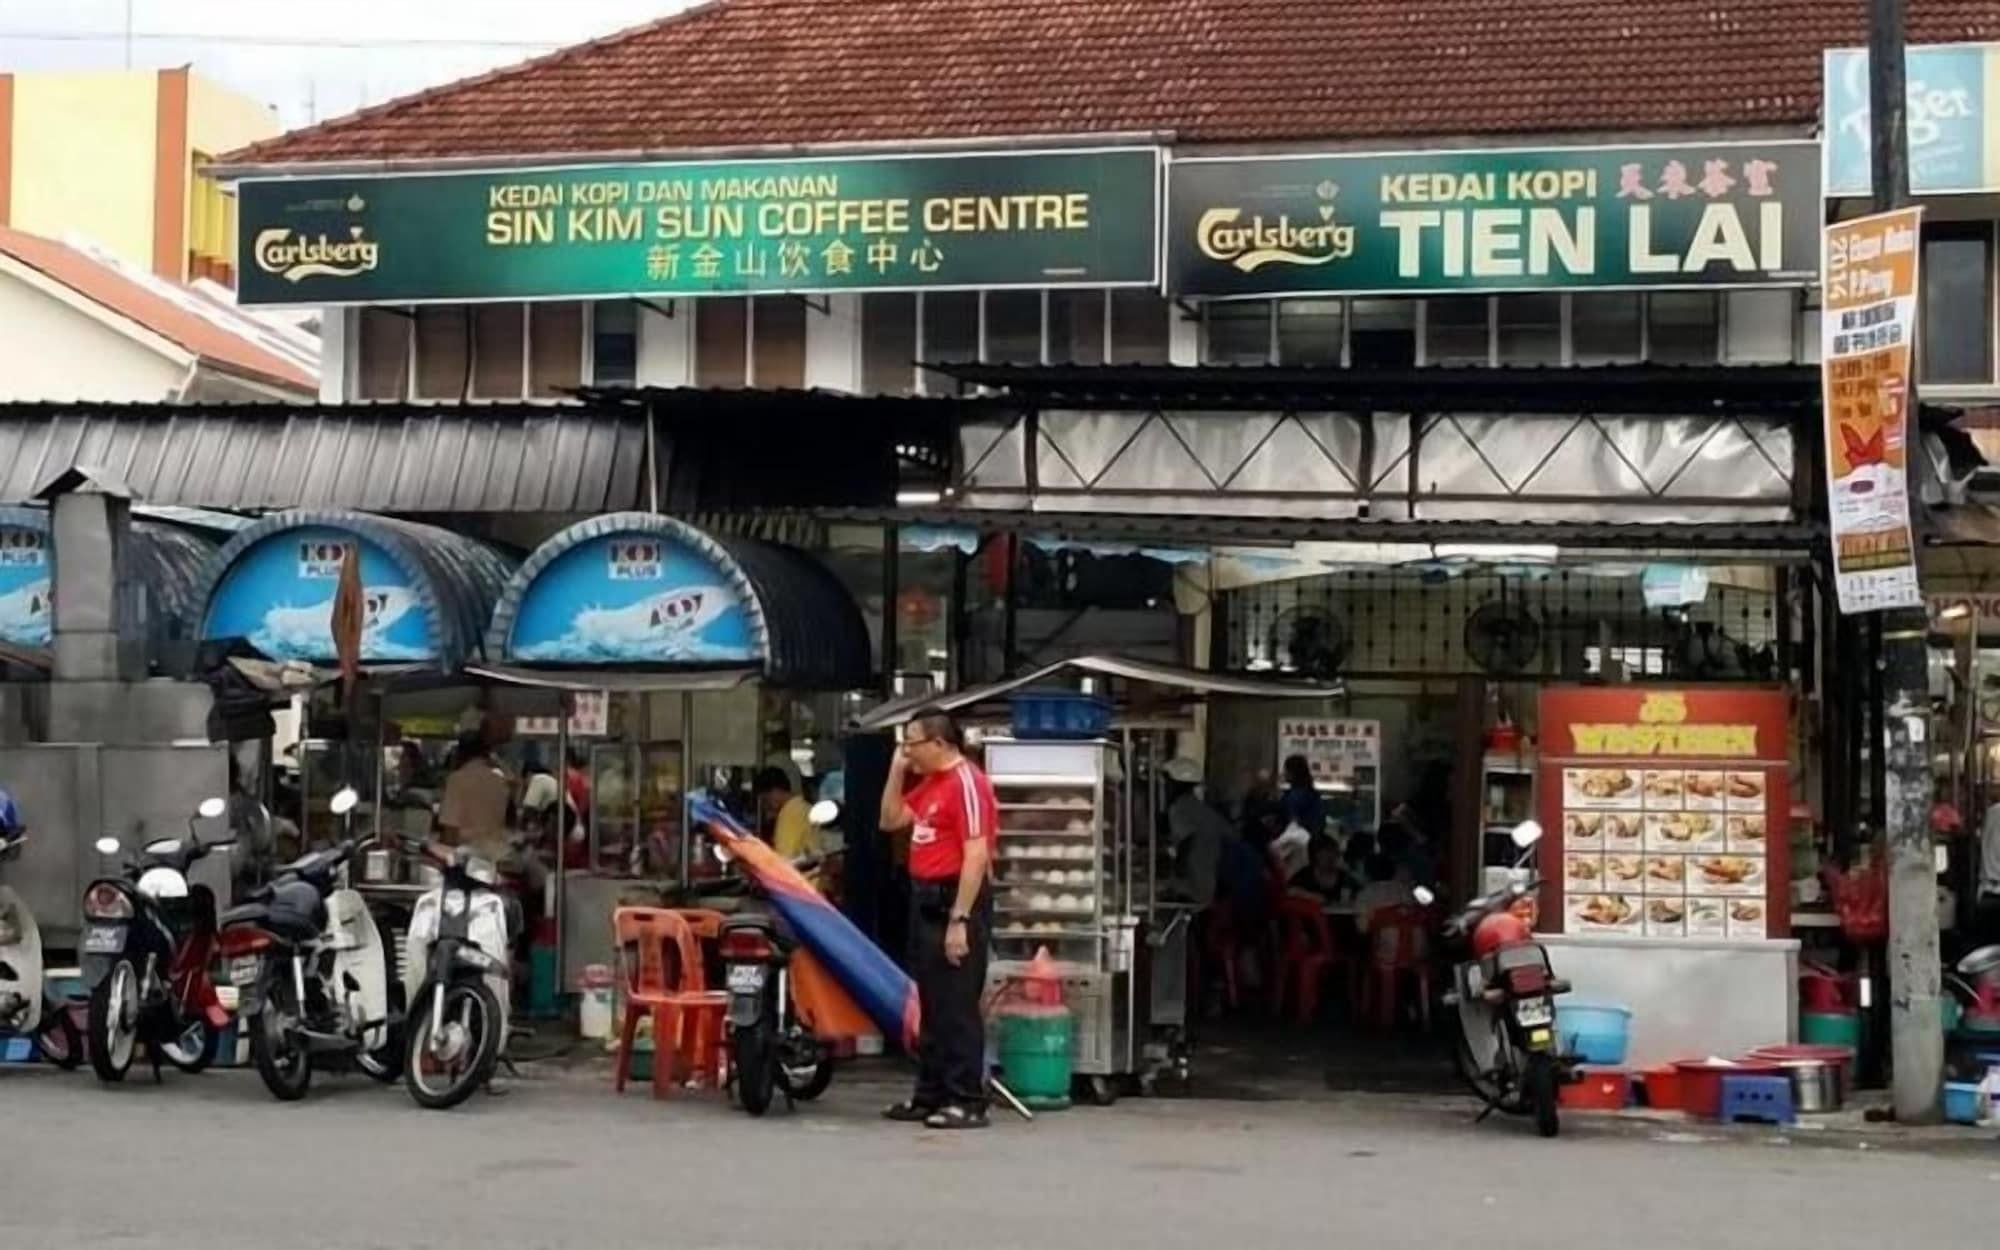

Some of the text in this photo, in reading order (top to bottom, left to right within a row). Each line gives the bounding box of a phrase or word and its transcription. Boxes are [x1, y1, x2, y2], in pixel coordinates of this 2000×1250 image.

[489, 174, 839, 208] KEDAI KOPI DAN MAKANAN
[1381, 168, 1597, 203] KEDAI KOPI
[486, 193, 1090, 245] SIN KIM SUN COFFEE CENTRE
[1197, 204, 1355, 273] Carlsberg
[1379, 206, 1596, 278] TIEN
[1629, 201, 1783, 273] LAI
[254, 225, 379, 284] Carlsberg
[646, 238, 945, 281] 新金山饮食中心
